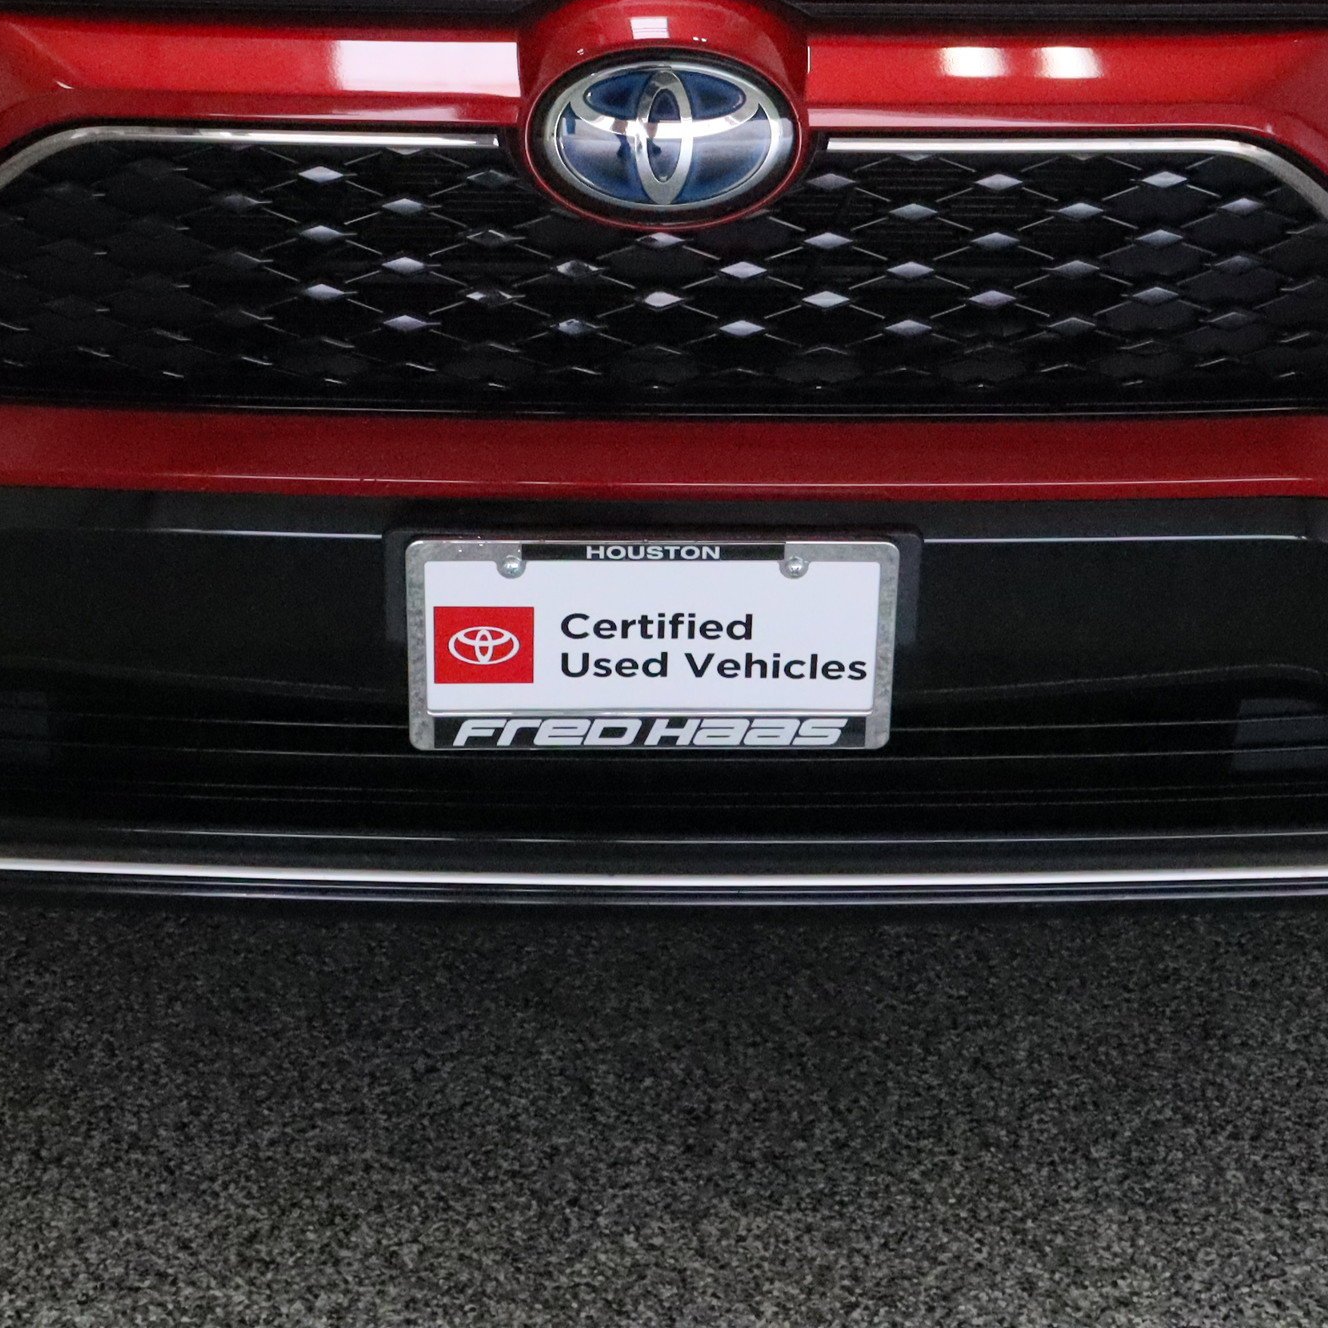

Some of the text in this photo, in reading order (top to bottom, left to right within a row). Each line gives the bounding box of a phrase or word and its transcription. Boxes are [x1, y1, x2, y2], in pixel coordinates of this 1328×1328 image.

[585, 545, 721, 560] HOUSTON
[560, 612, 754, 641] Certified
[560, 651, 867, 681] Used Vehicles
